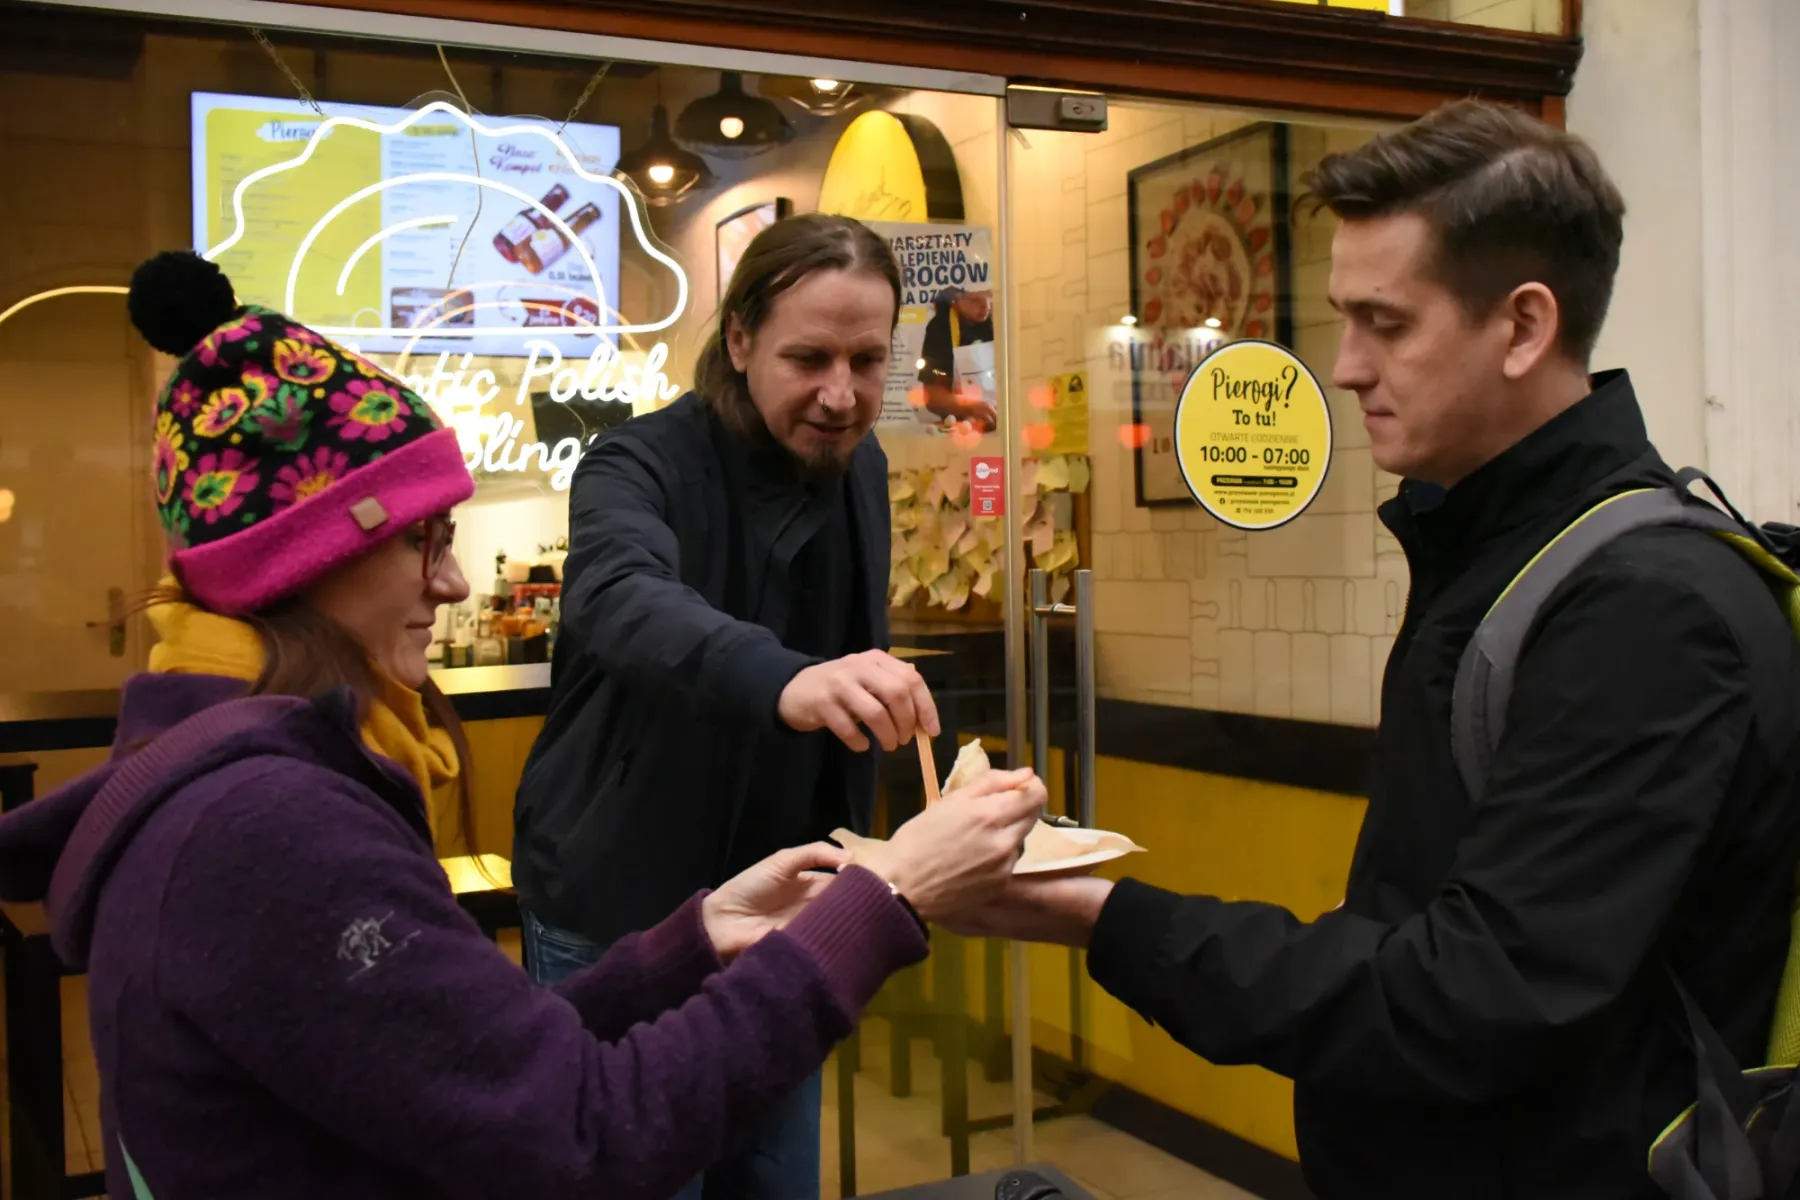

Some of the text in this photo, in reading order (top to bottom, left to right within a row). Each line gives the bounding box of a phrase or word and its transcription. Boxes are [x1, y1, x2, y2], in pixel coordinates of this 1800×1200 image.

[900, 250, 966, 267] LEPIENIA
[516, 340, 680, 405] Polish
[1211, 365, 1299, 412] Pierogi?
[1232, 410, 1277, 426] To tu!
[1210, 432, 1249, 443] OTWARTE
[465, 411, 598, 491] ling
[1200, 446, 1247, 463] 10:00
[1263, 448, 1310, 465] 07:00
